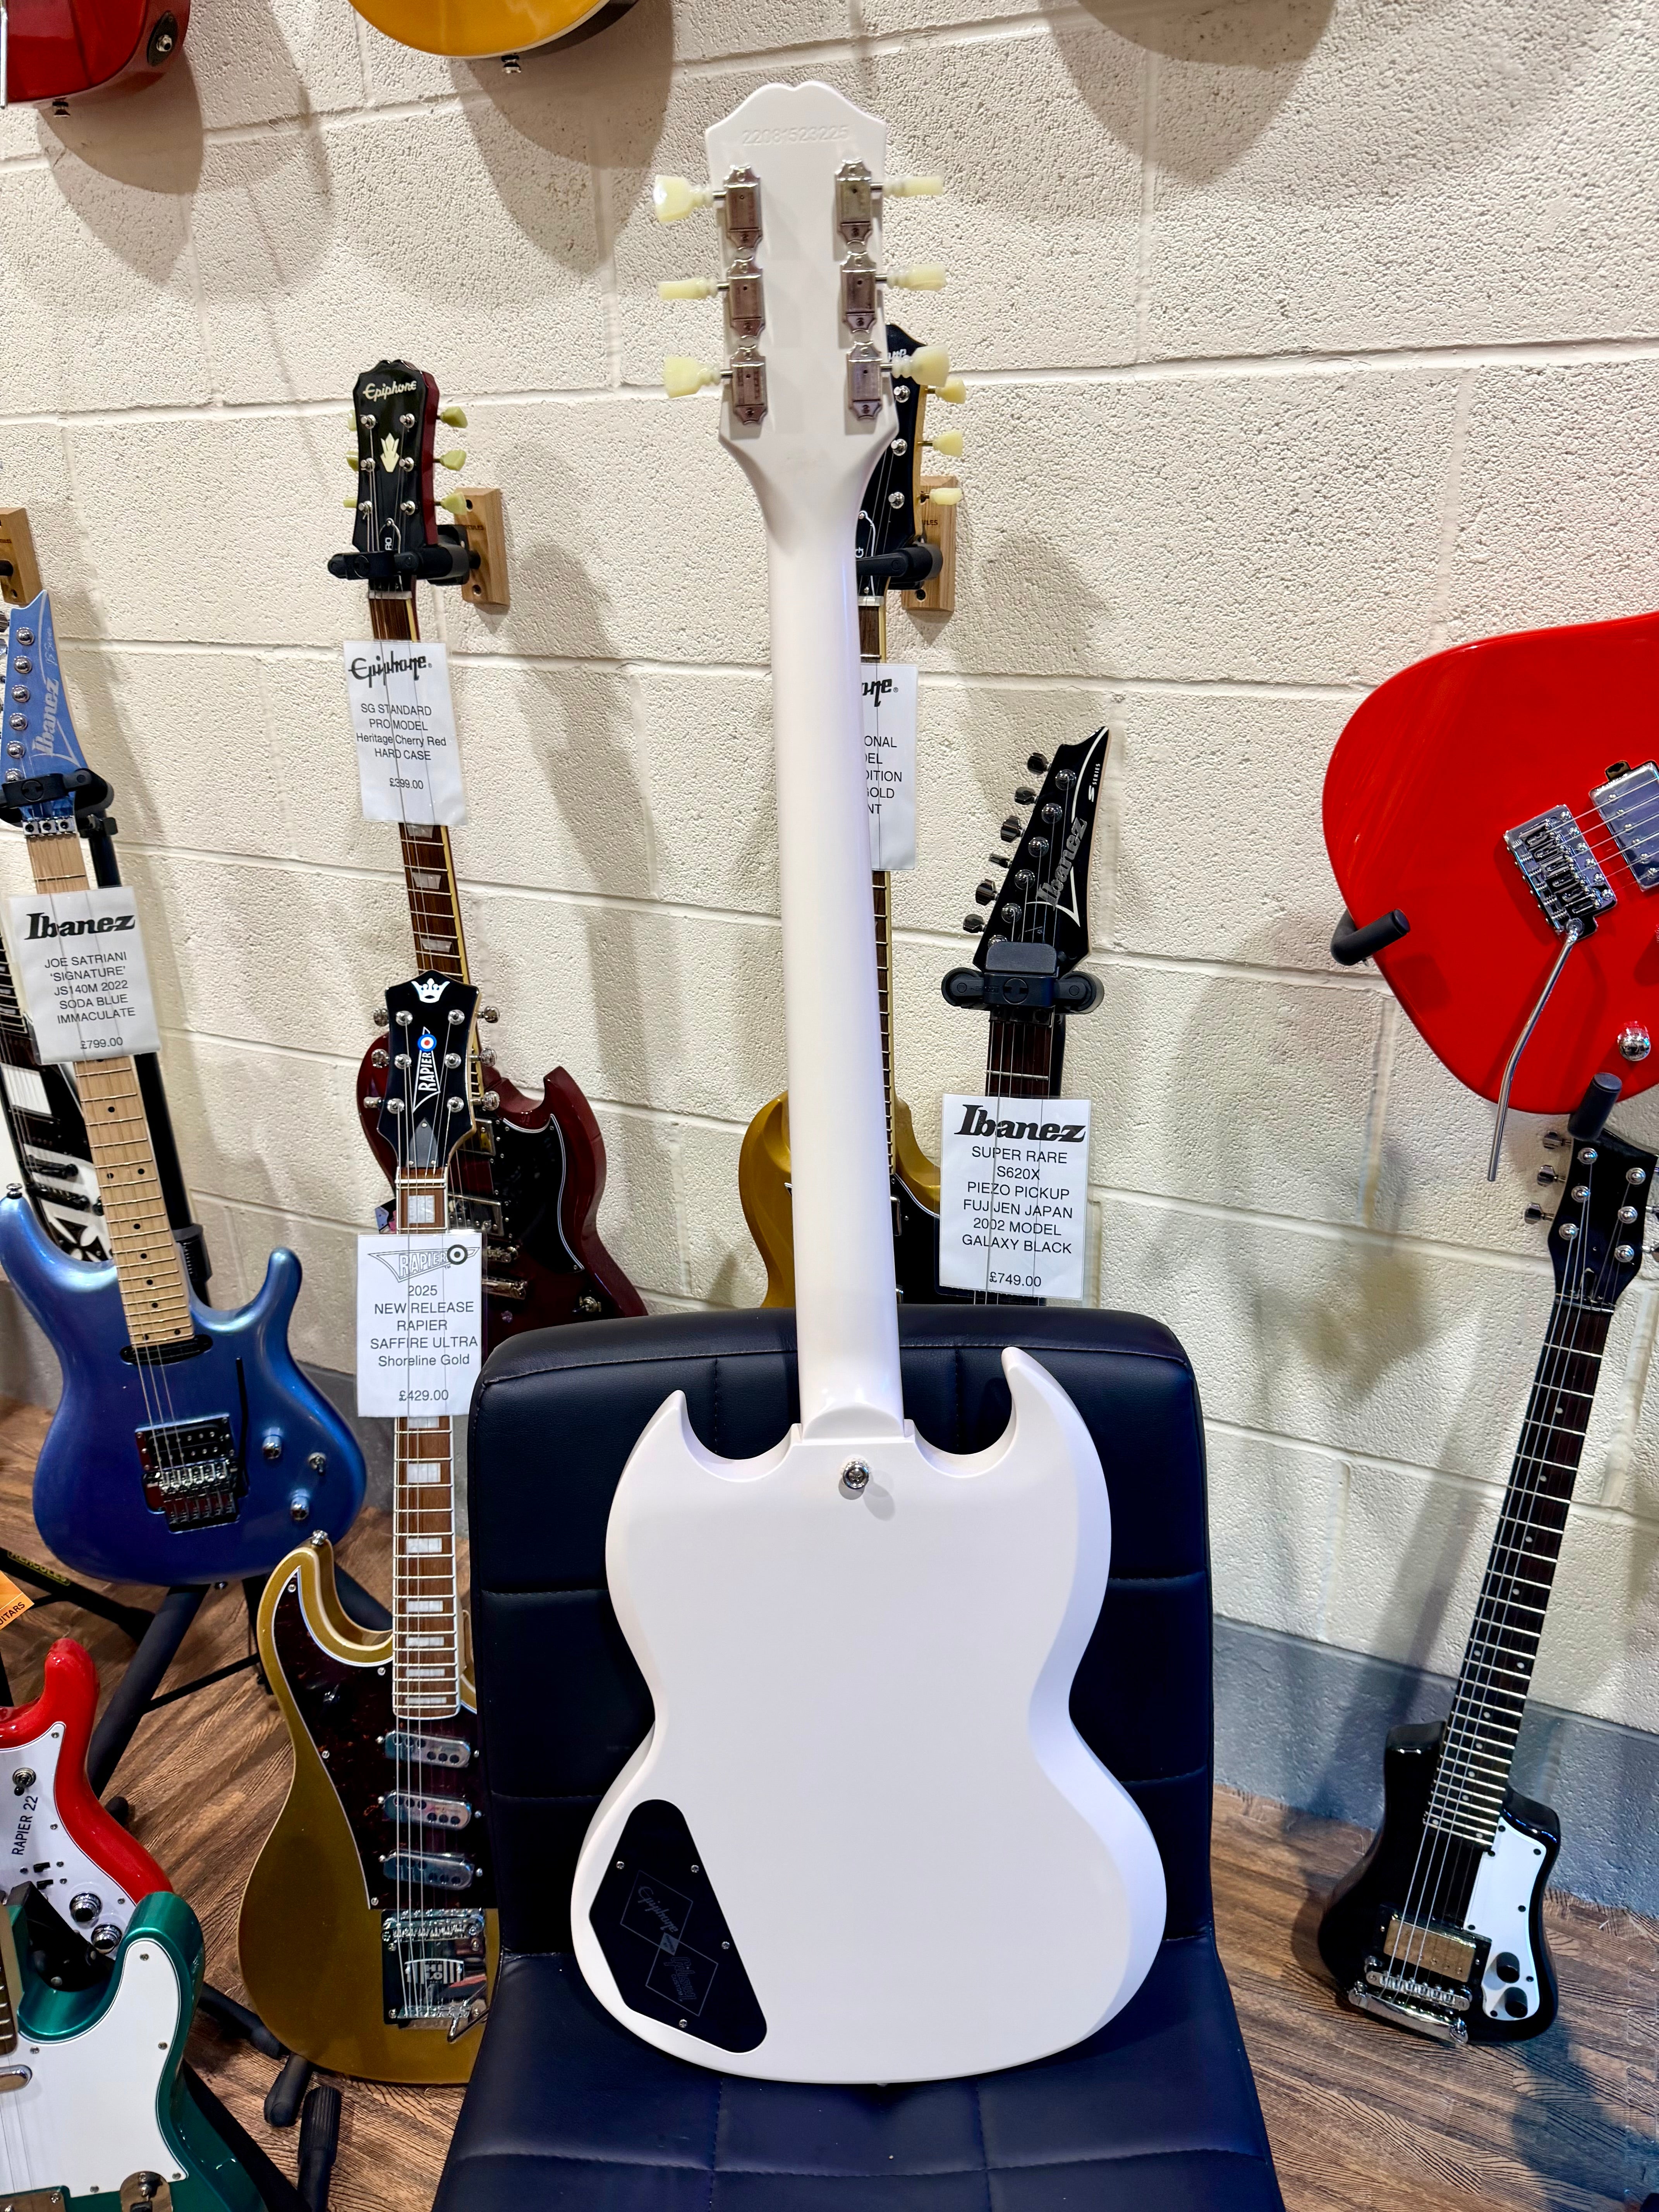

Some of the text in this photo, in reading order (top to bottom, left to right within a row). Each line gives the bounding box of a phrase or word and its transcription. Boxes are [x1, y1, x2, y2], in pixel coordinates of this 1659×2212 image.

[362, 380, 417, 402] Epiphone
[349, 651, 427, 688] Epiphone
[31, 677, 59, 757] Ibanez
[361, 703, 431, 716] SG STANDARD
[369, 719, 428, 731] PRO MODEL
[356, 733, 446, 747] Heritage Cherry Red
[375, 748, 431, 761] HARD CASE
[866, 753, 883, 764] EL
[390, 778, 423, 789] £399.00
[1088, 763, 1101, 802] S SERIES
[867, 787, 895, 798] OLD
[1035, 816, 1087, 911] Ibanez
[24, 912, 136, 940] Ibanez
[45, 951, 127, 969] JOE SATRIANI
[54, 980, 128, 996] JS140M 2022
[60, 994, 128, 1010] SODA BLUE
[57, 1007, 136, 1024] IMMACULATE
[81, 1037, 123, 1049] £799.00
[418, 1052, 437, 1091] RAPIER
[954, 1104, 1086, 1142] Ibanez
[972, 1146, 1067, 1164] SUPER RARE
[997, 1166, 1040, 1180] S620X
[967, 1182, 1070, 1200] PIEZO PICKUP
[964, 1199, 1072, 1218] FUJJEN JAPAN
[973, 1218, 1061, 1236] 2002 MODEL
[962, 1234, 1072, 1254] GALAXY BLACK
[399, 1252, 447, 1278] RAPIER
[989, 1272, 1041, 1286] £749.00
[409, 1285, 438, 1296] 2025
[374, 1302, 474, 1314] NEW RELEASE
[397, 1320, 447, 1331] RAPIER
[370, 1336, 478, 1349] SAFFIRE ULTRA
[378, 1354, 469, 1367] Shoreline Gold
[399, 1389, 448, 1401] £429.00
[12, 1796, 38, 1855] RAPIER 22
